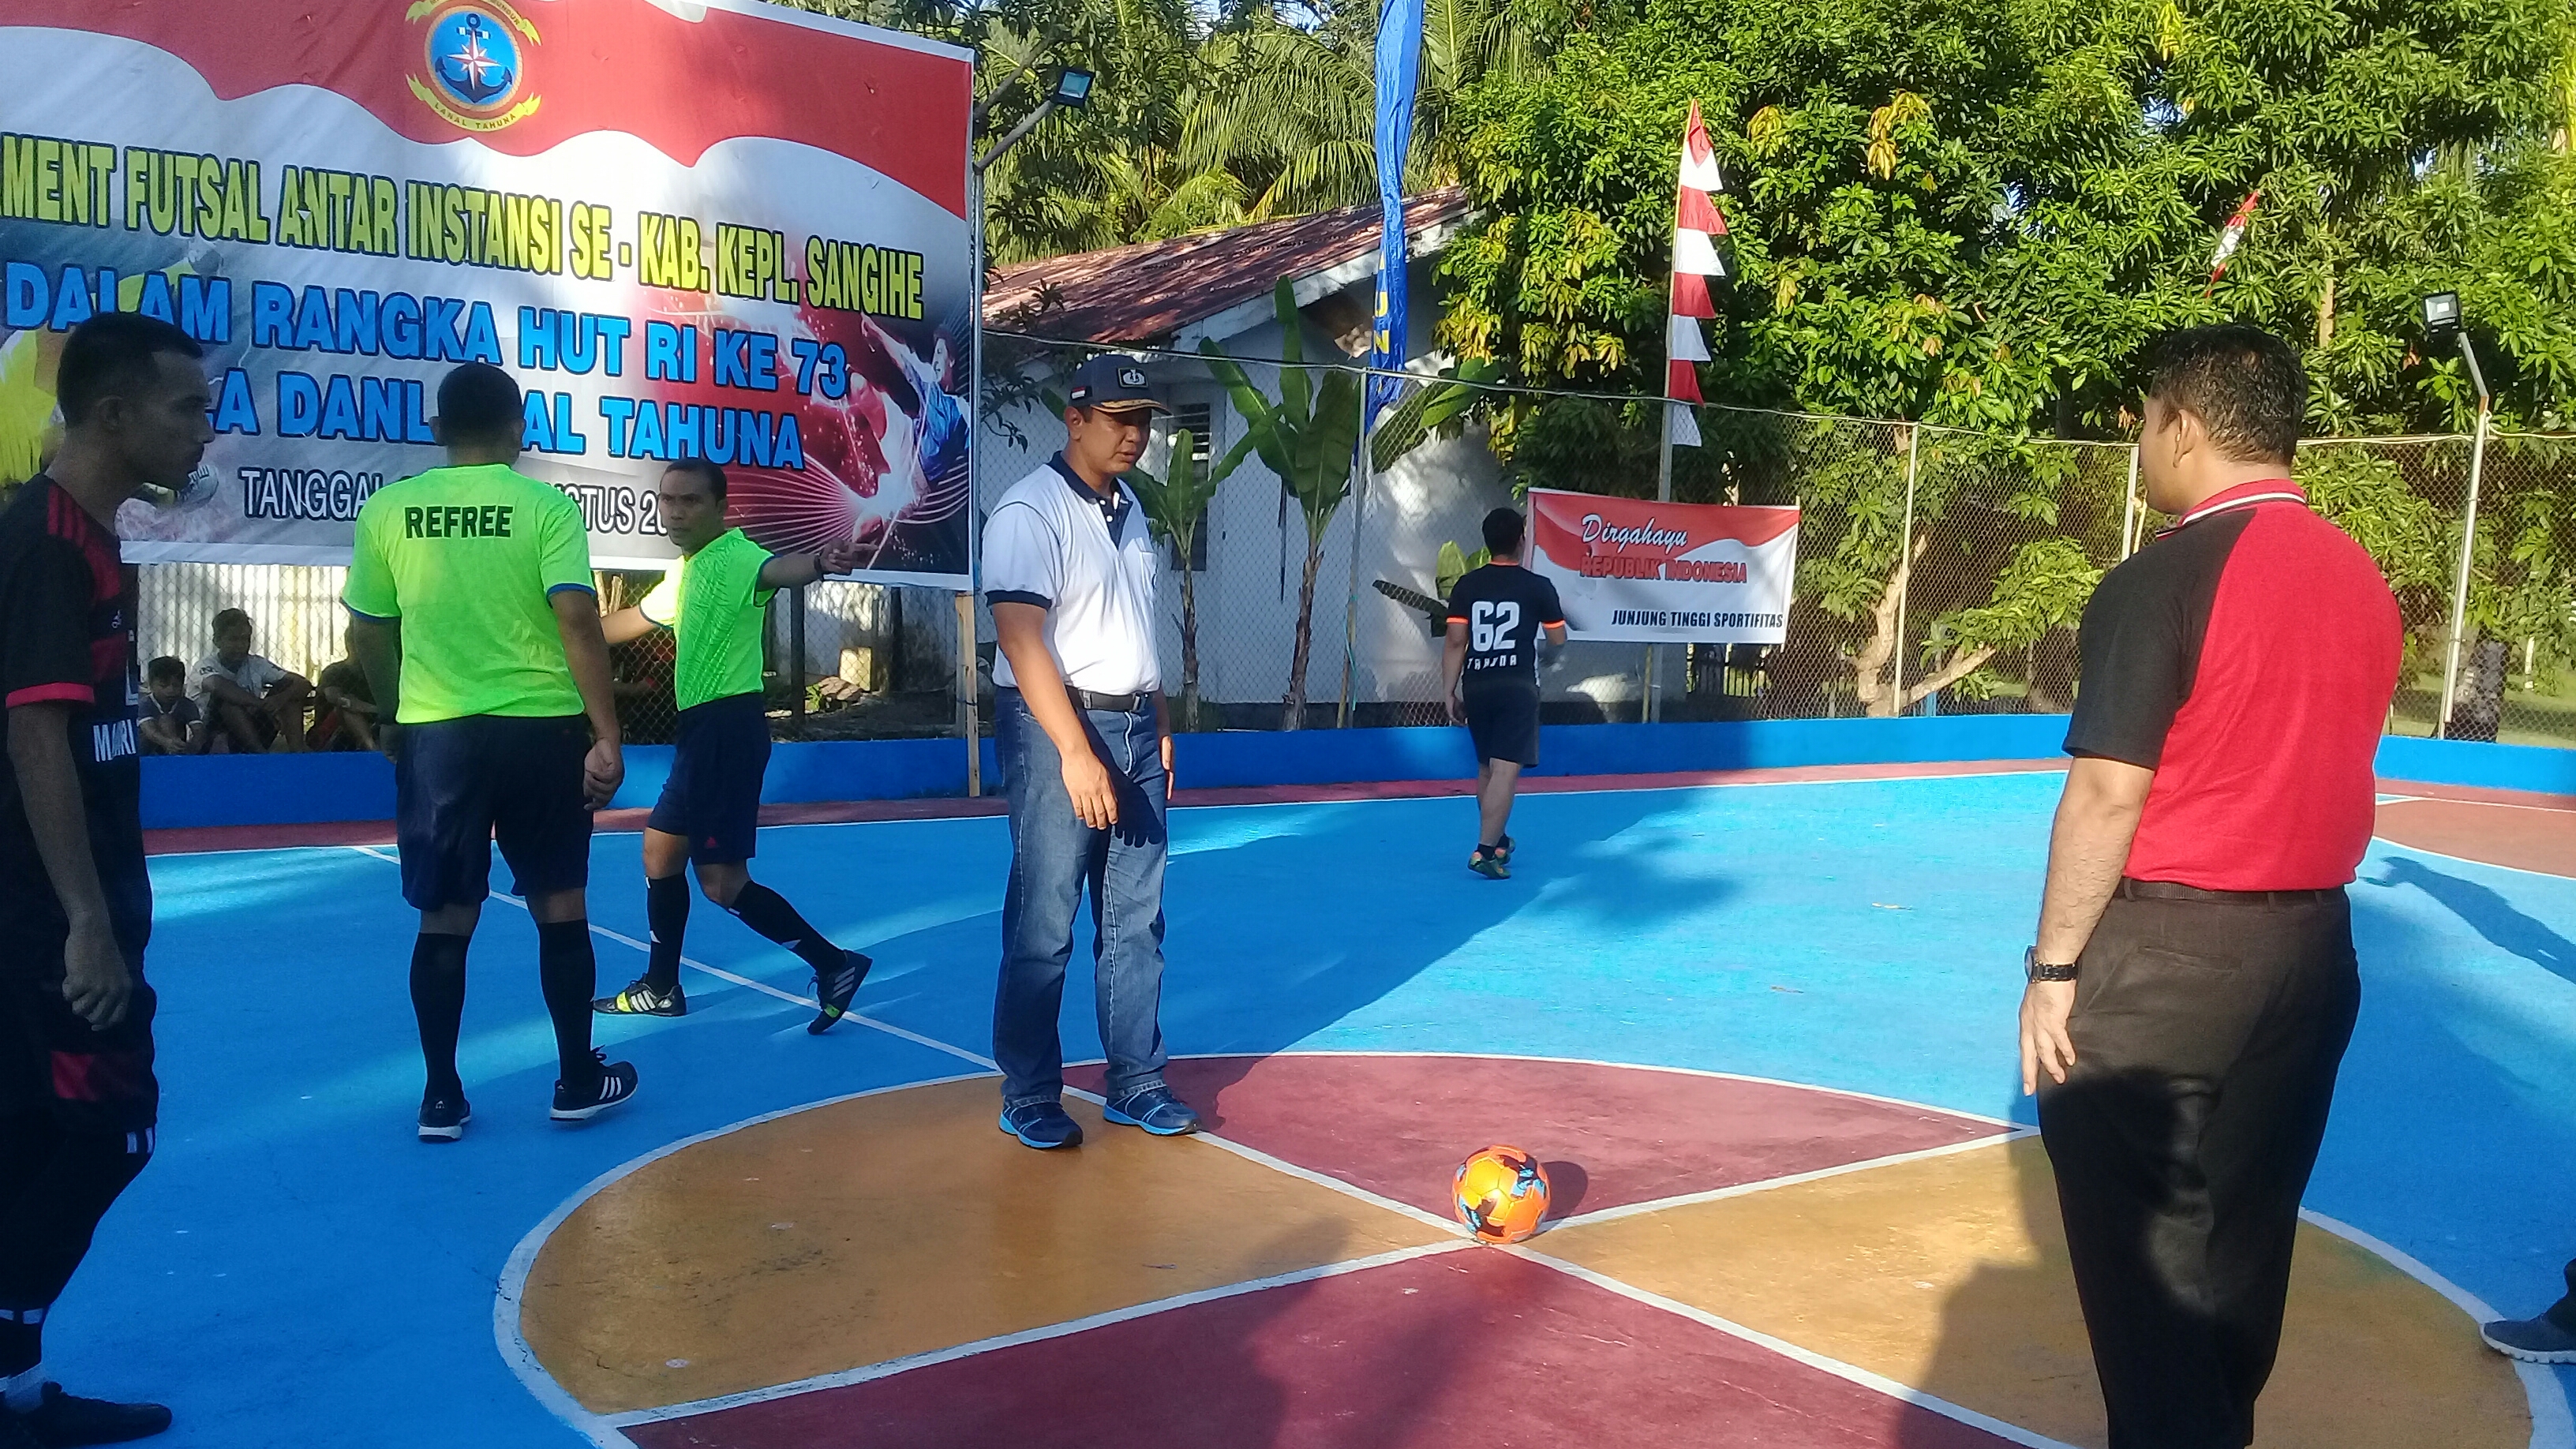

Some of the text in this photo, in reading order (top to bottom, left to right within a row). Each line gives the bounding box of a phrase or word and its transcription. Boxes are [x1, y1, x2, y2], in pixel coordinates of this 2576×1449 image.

[435, 103, 516, 129] LANAL TAHUNA
[0, 133, 117, 228] MENT
[125, 147, 270, 244] FUTSAL
[279, 165, 395, 257] ANTAR
[406, 180, 563, 275] INSTANSI
[569, 201, 612, 280] SE
[638, 212, 710, 293] KAB.
[715, 222, 799, 305] KEPL.
[806, 235, 924, 320] SANGIHE
[253, 281, 503, 366] RANGKA
[518, 306, 629, 376] HUT
[646, 320, 696, 382] RI
[713, 329, 778, 391] KE
[792, 339, 849, 399] 73
[600, 396, 806, 470] TAHUNA
[238, 467, 384, 522] TANGGA
[405, 505, 513, 538] REFREE
[1581, 514, 1687, 554] Dirgahayu
[1580, 555, 1747, 583] REPUBLIK INDONESIA
[1472, 601, 1519, 651] 62
[1612, 610, 1783, 628] JUNJUNG TINGGI SPORTIFITAS
